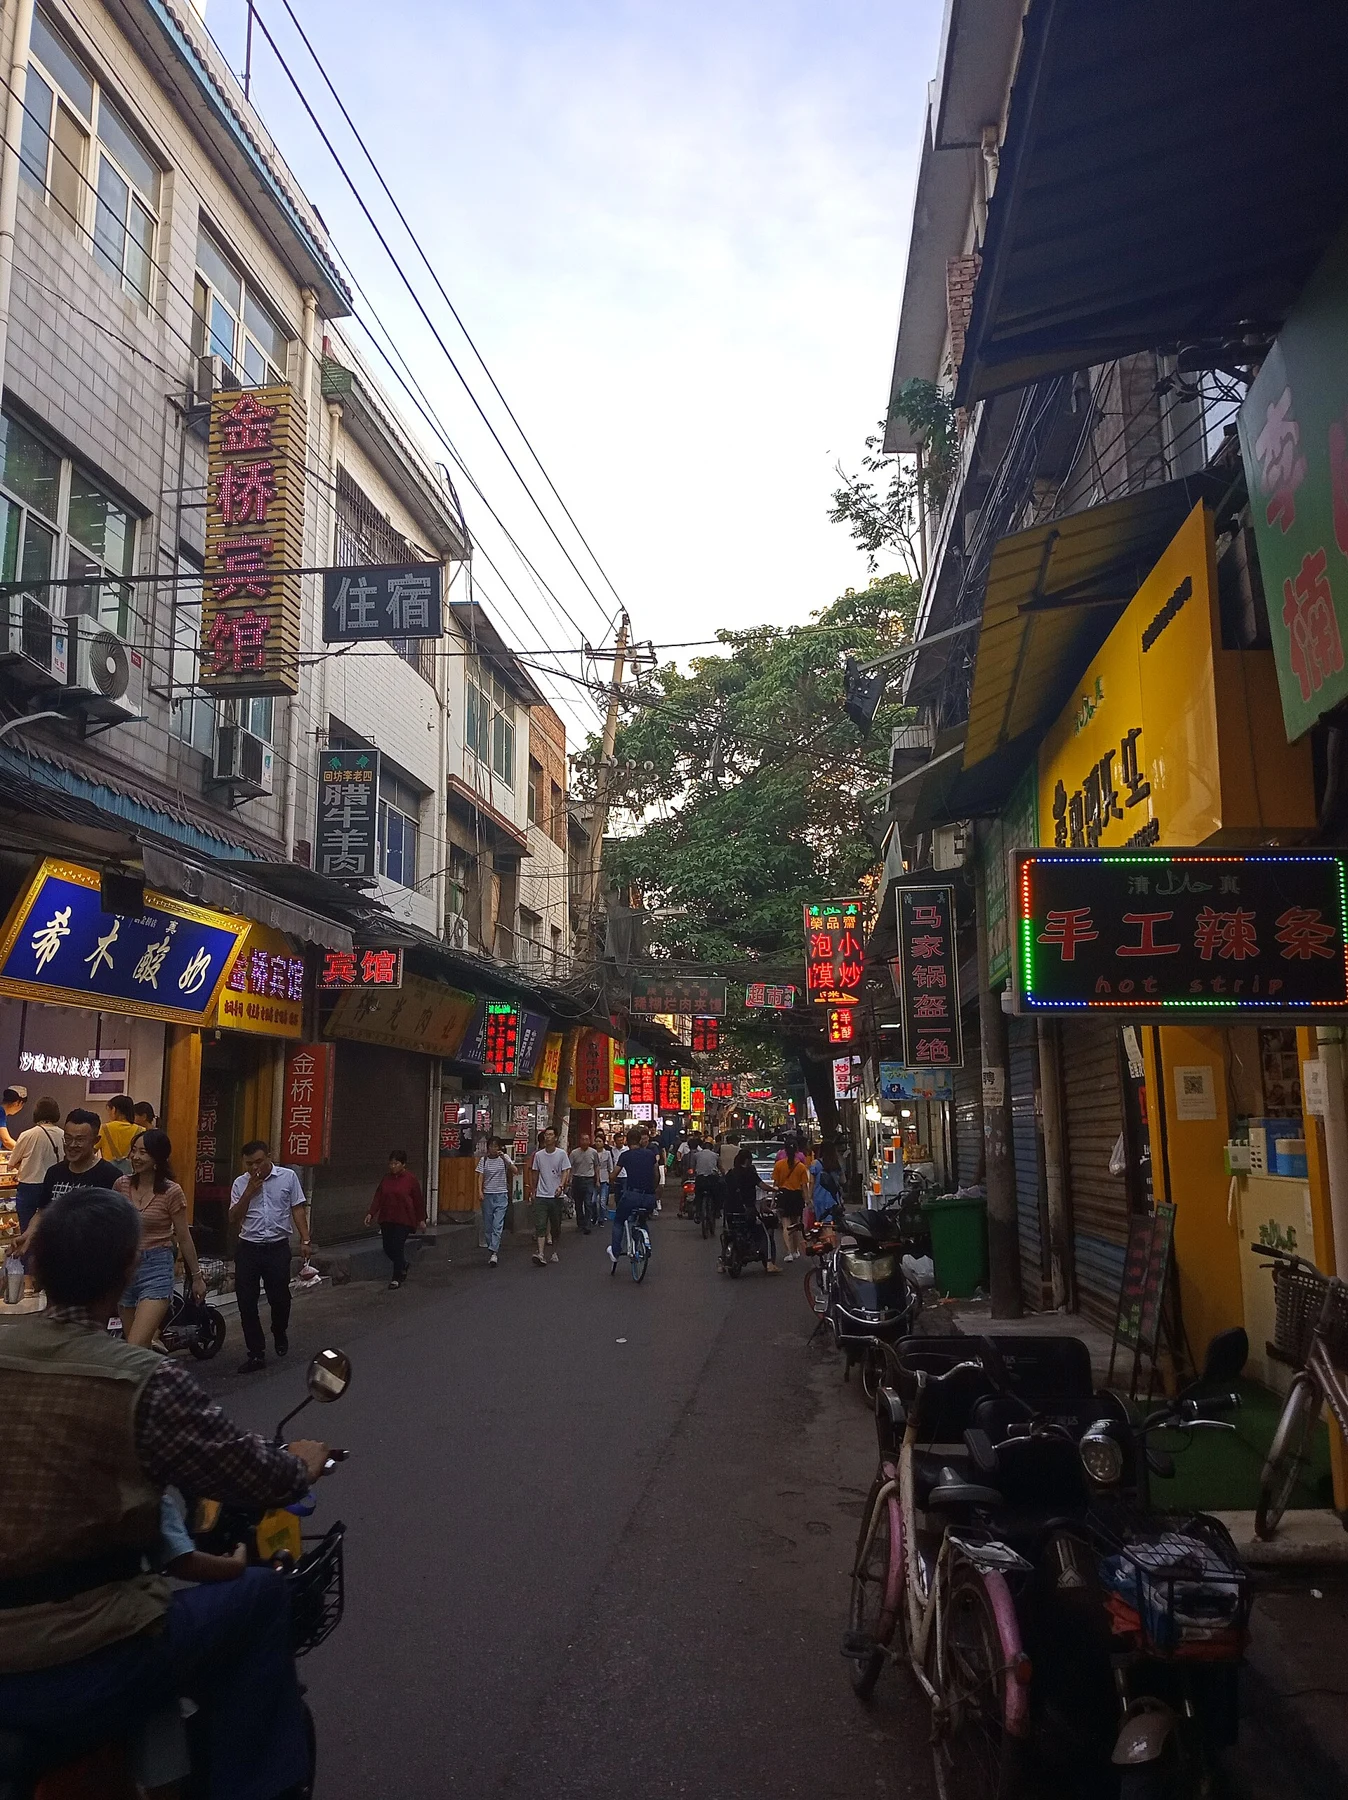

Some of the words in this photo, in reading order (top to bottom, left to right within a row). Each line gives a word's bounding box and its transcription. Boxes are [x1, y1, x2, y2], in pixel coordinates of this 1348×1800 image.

[208, 393, 278, 674] 金桥宾馆
[332, 572, 431, 632] 住宿
[323, 770, 373, 782] 回坊李老四
[322, 783, 371, 874] 腊牛羊肉
[1127, 875, 1149, 895] 清
[1220, 875, 1241, 895] 真
[31, 906, 212, 994] 希木酸奶
[1037, 905, 1336, 962] 手工辣条
[323, 950, 397, 983] 宾馆
[748, 985, 784, 1005] 超市
[911, 906, 951, 1062] 马家锅盔一绝
[1095, 975, 1159, 994] hot
[1189, 974, 1285, 996] strip
[287, 1051, 315, 1156] 金桥宾馆
[441, 1102, 461, 1150] 冒菜
